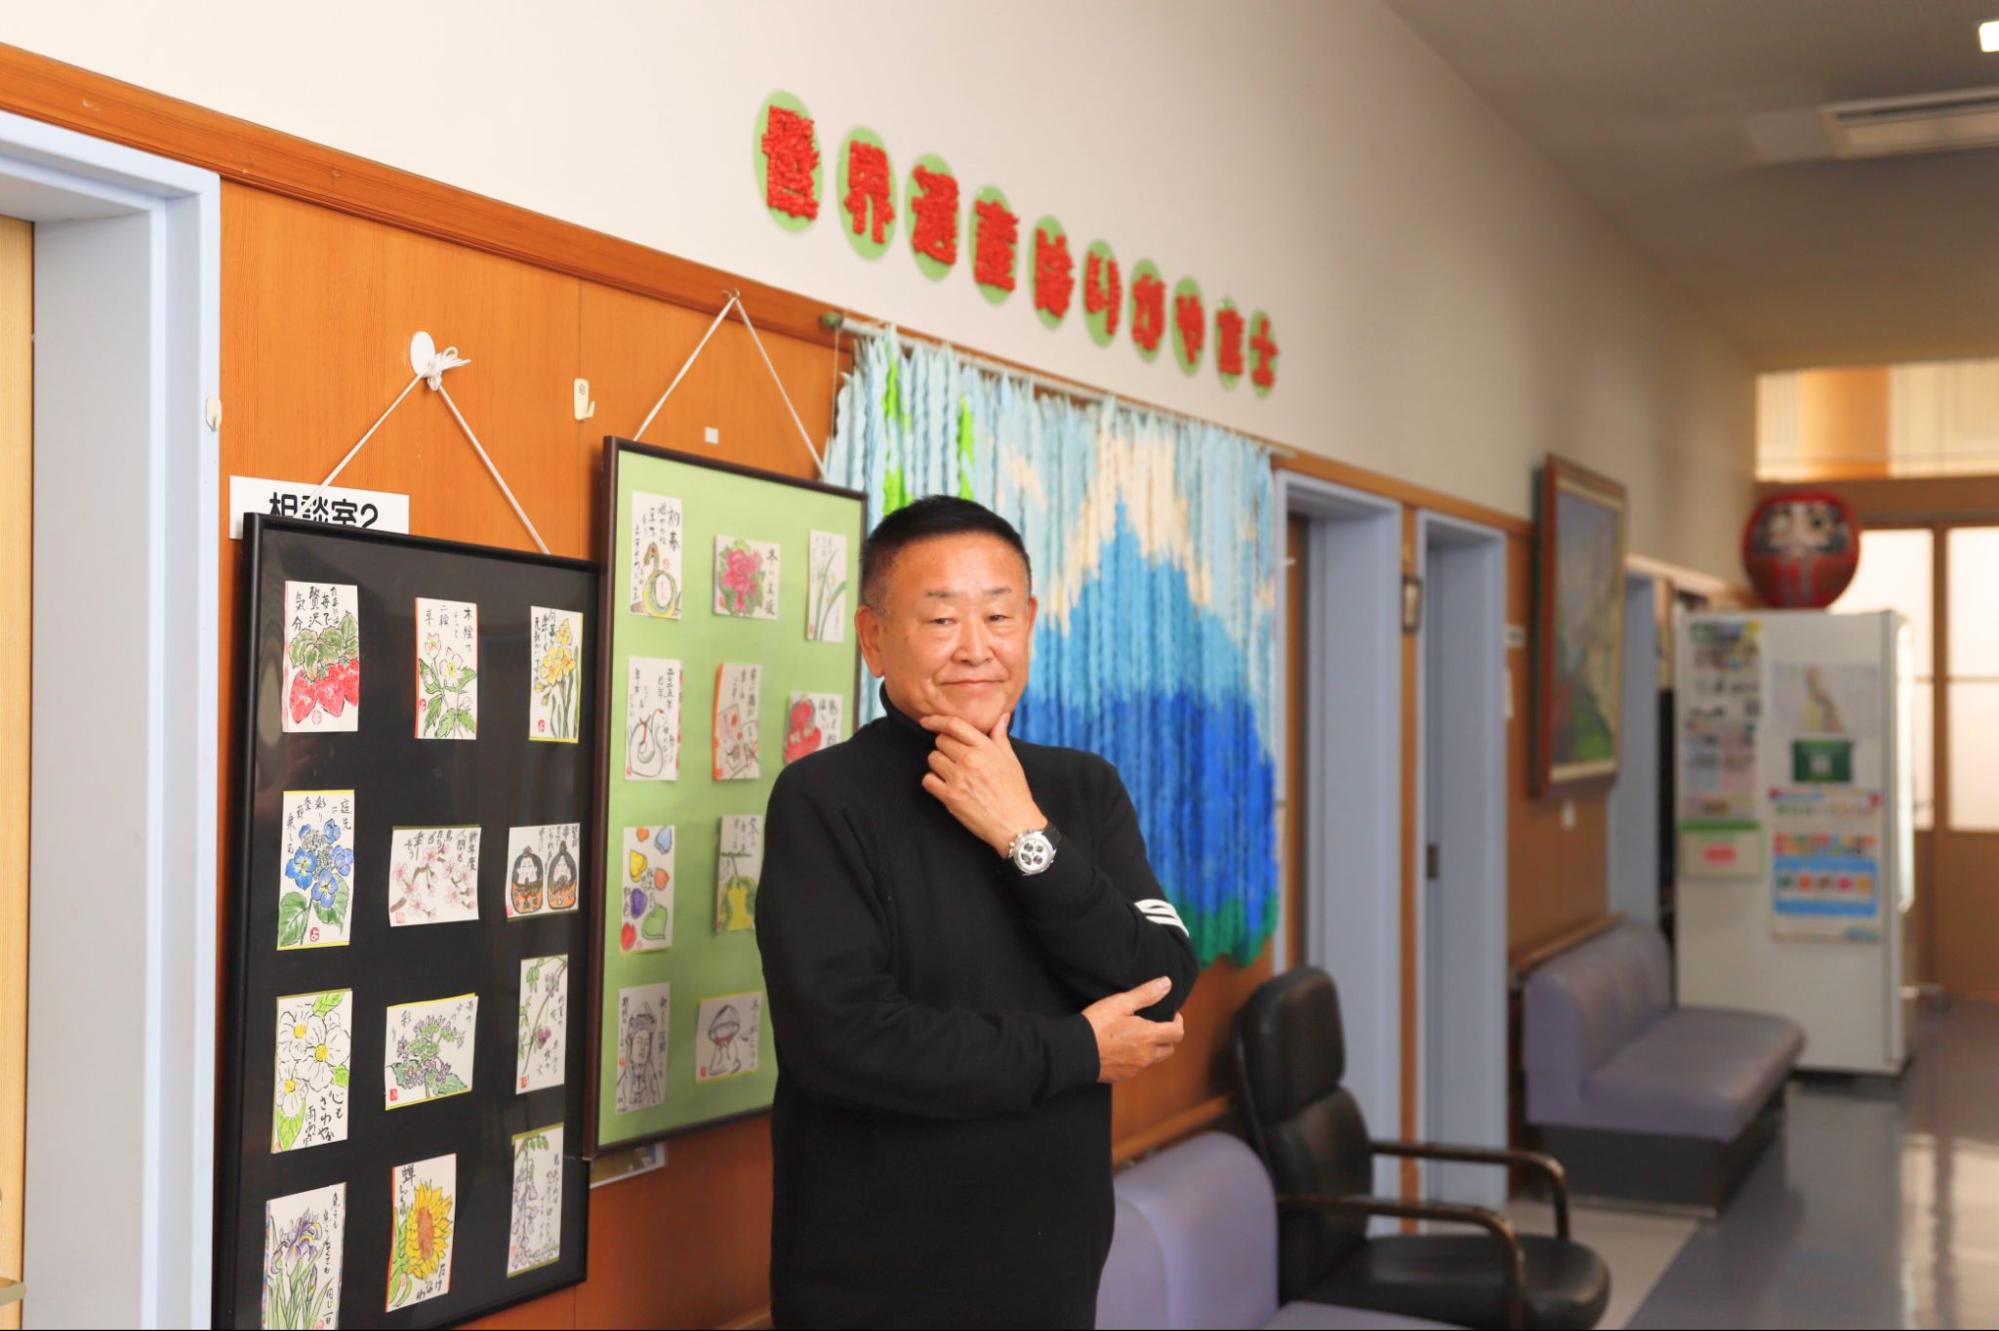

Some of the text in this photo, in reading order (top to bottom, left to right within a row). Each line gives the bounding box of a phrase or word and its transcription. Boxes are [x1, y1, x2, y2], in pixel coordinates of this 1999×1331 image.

[318, 1095, 335, 1141] さわやか
[329, 1090, 344, 1119] 心も
